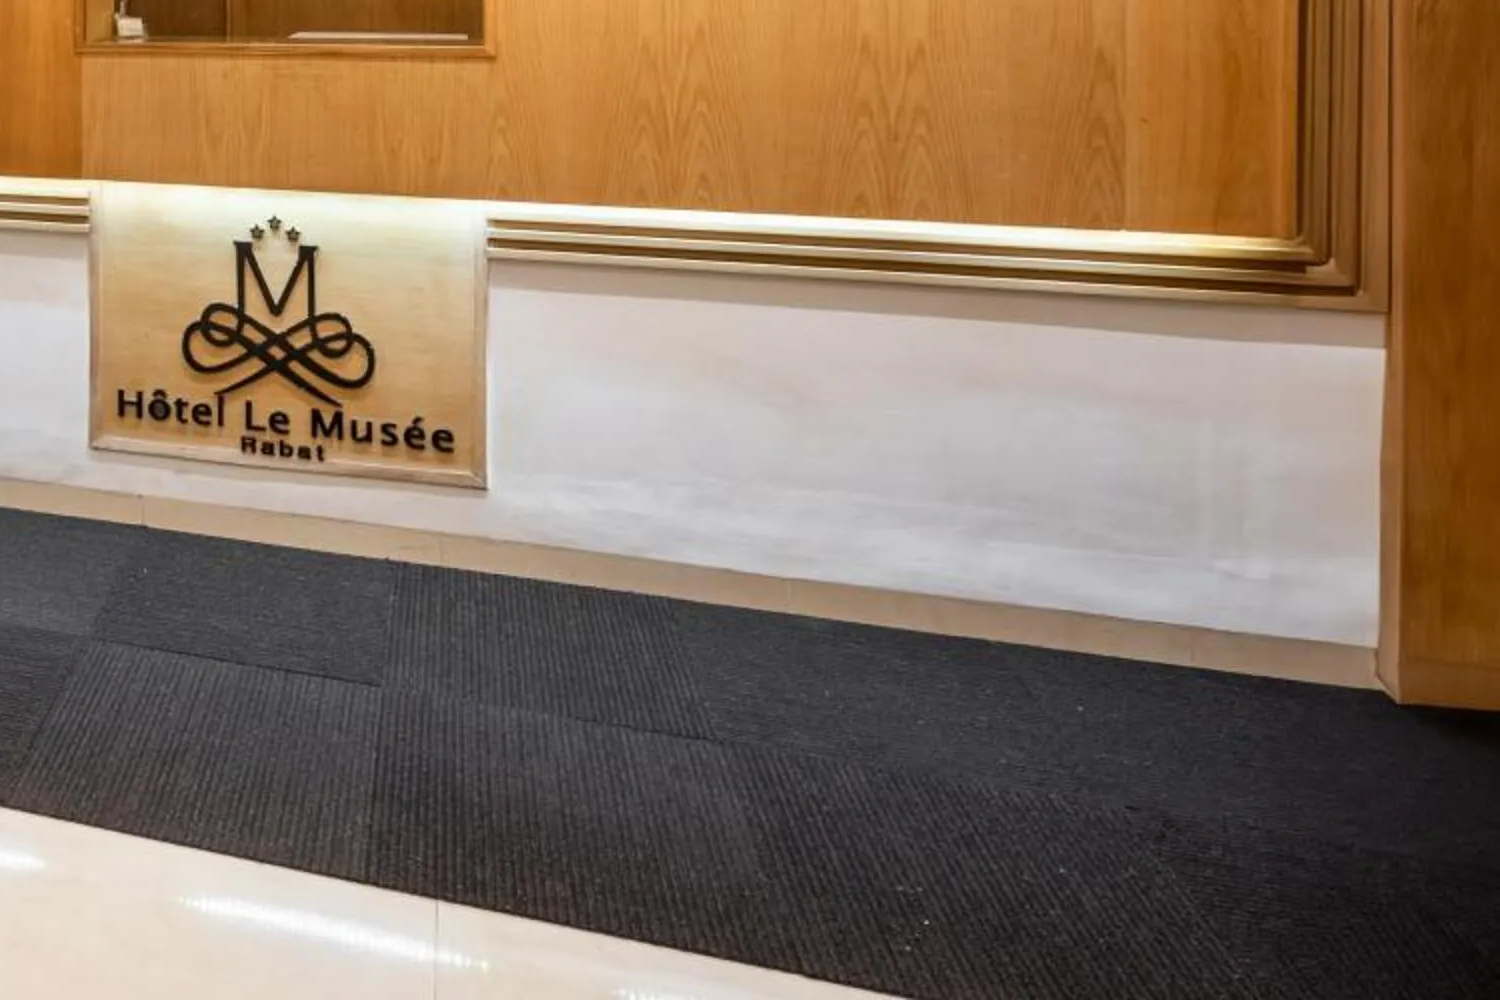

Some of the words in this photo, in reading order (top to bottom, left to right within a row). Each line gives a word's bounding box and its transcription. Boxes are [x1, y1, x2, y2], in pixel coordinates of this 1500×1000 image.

[116, 389, 226, 428] Hôtel
[243, 400, 291, 436] Le
[310, 408, 455, 453] Musée
[240, 436, 326, 461] Rabat
